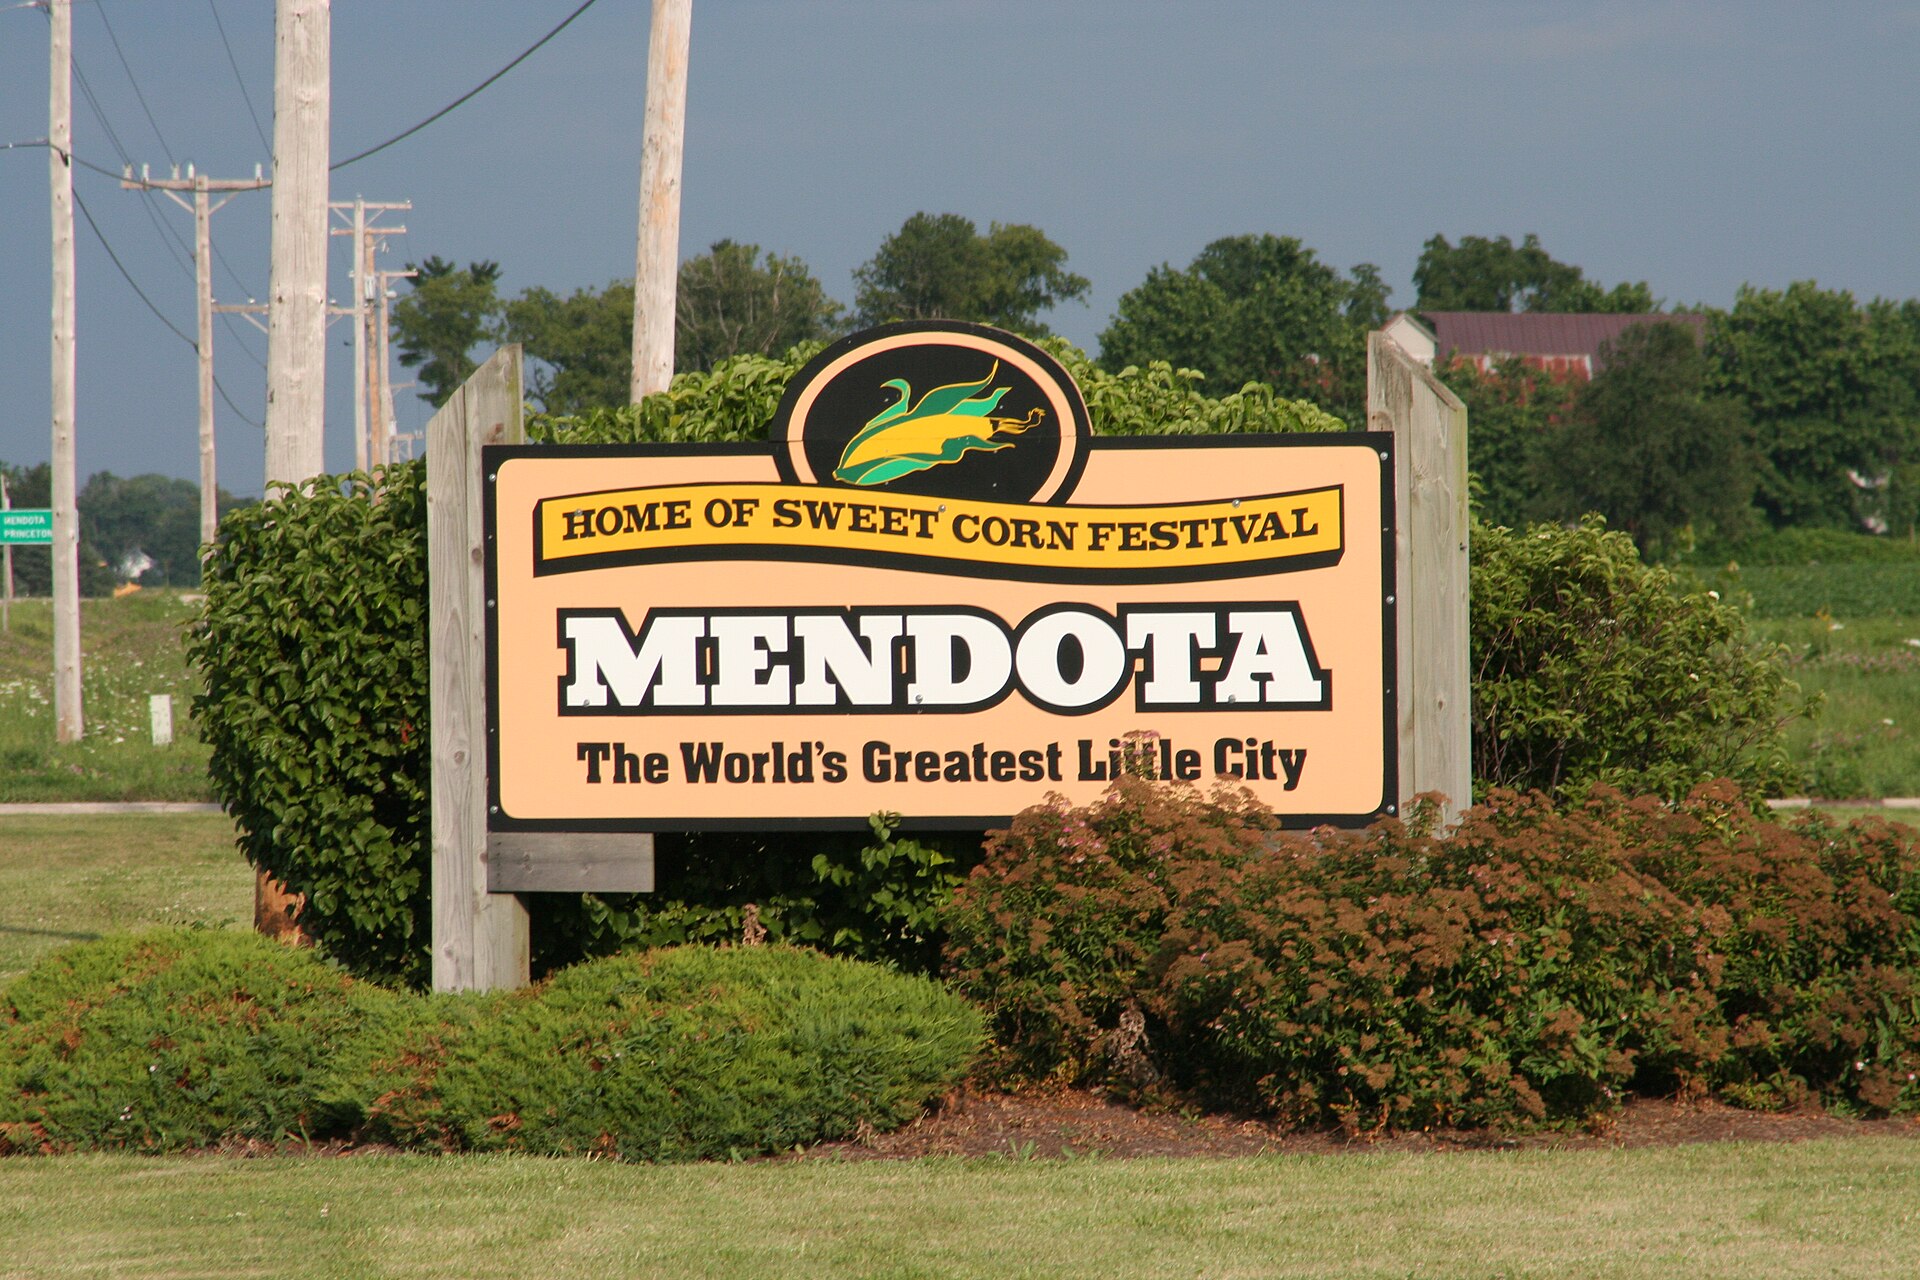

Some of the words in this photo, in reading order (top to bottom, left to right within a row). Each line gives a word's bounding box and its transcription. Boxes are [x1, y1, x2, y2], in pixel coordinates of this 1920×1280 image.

[4, 516, 45, 525] MENDOTA
[562, 500, 692, 541] HOME
[704, 498, 760, 528] OF
[772, 499, 940, 539] SWEET
[952, 514, 1078, 551] CORN
[1087, 507, 1319, 551] FESTIVAL
[564, 610, 1324, 709] MENDOTA
[577, 742, 669, 783] The
[680, 741, 848, 784] World's
[862, 740, 1062, 783] Greatest
[1214, 737, 1307, 791] City
